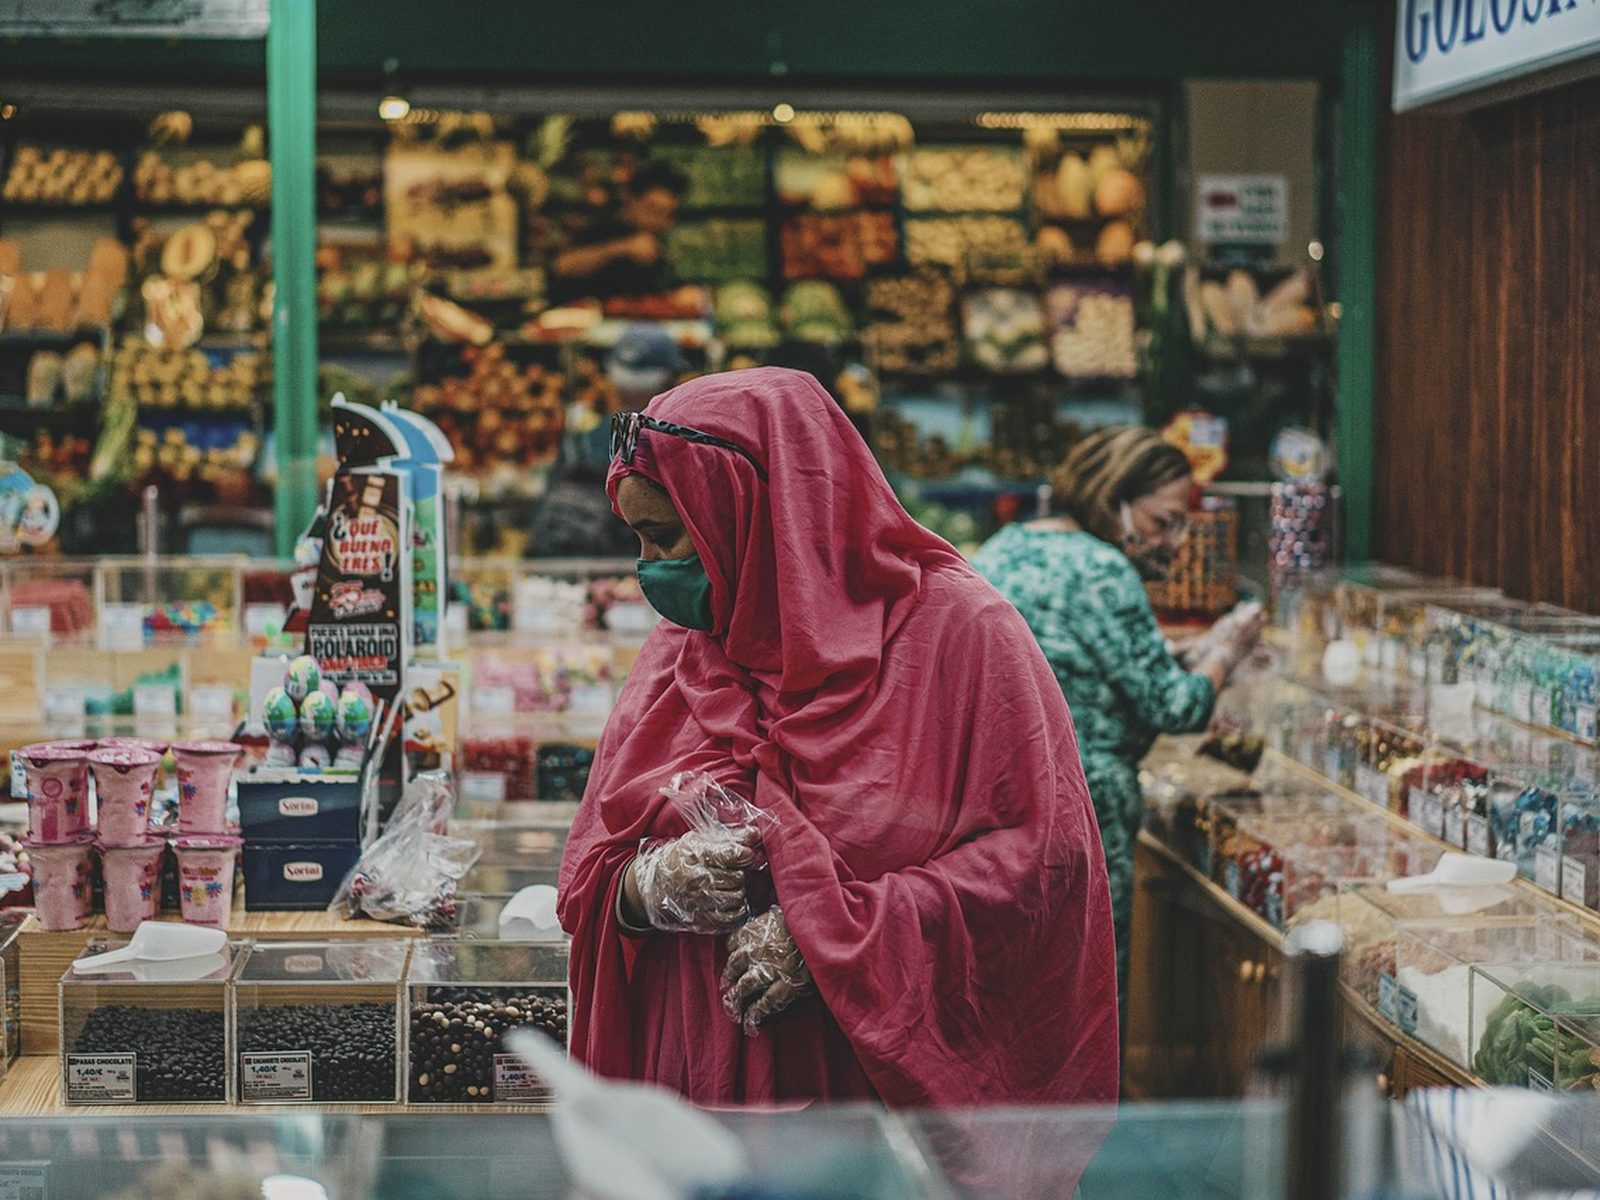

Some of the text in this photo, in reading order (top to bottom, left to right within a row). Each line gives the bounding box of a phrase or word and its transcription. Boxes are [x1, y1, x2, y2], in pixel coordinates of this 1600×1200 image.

[1405, 0, 1597, 63] GOLO
[339, 539, 392, 554] BUENO
[313, 637, 395, 658] POLAROID
